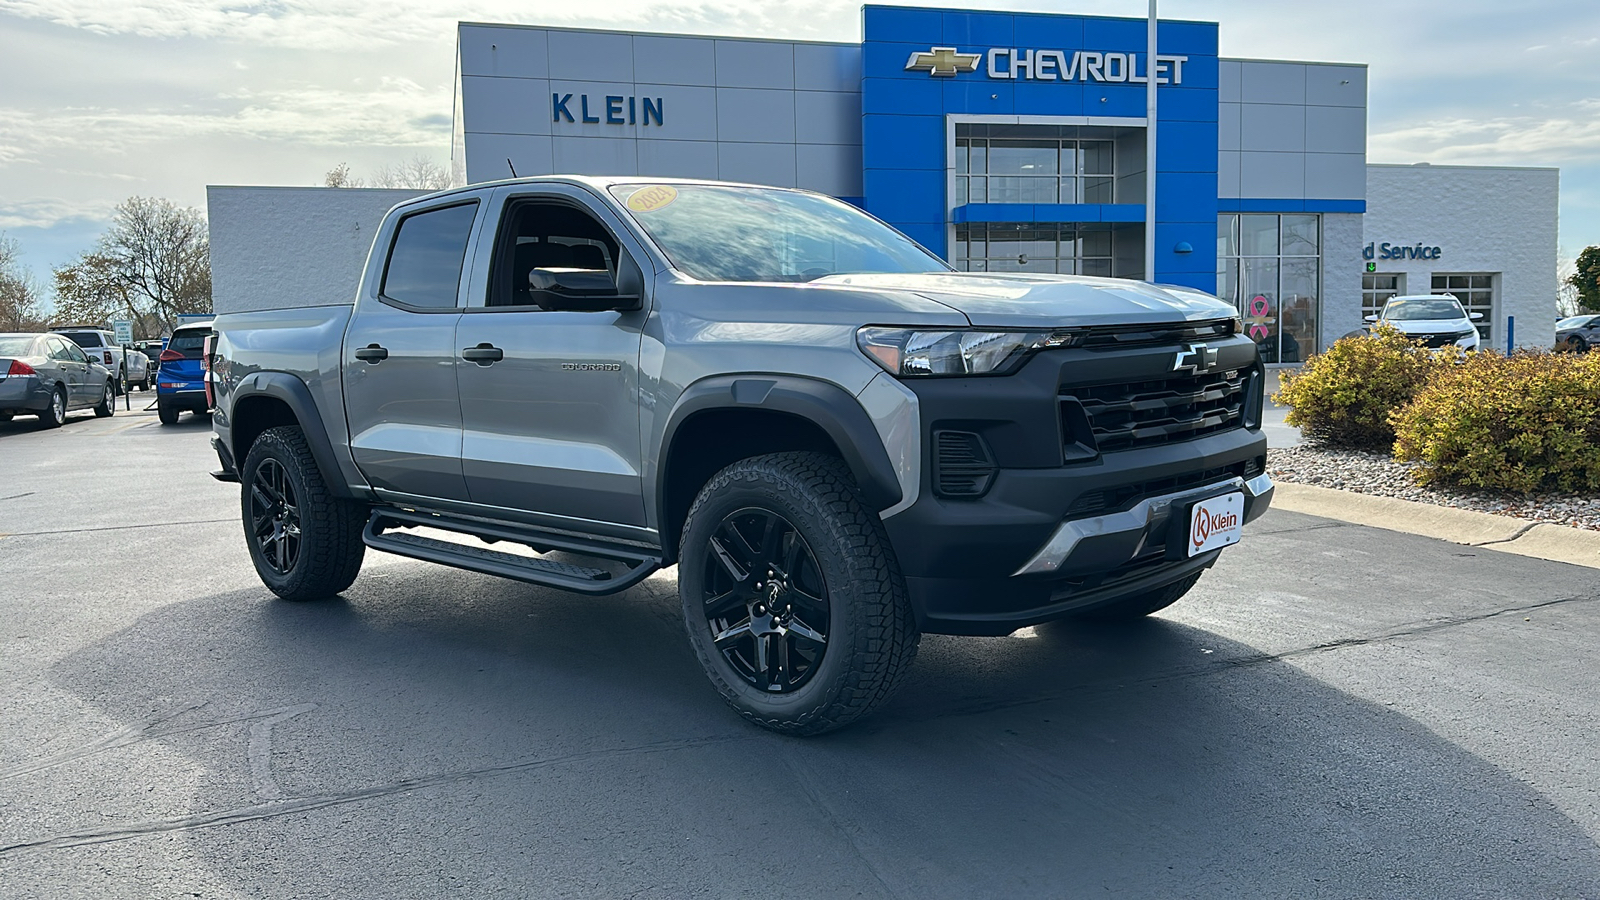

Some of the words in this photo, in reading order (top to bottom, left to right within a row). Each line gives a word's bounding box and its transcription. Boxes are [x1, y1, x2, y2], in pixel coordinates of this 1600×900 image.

[988, 48, 1188, 84] CHEVROLET
[553, 93, 663, 126] KLEIN
[634, 186, 672, 209] 2024
[1379, 242, 1441, 260] Service
[561, 362, 621, 371] COLORADO
[1211, 511, 1237, 531] Klein
